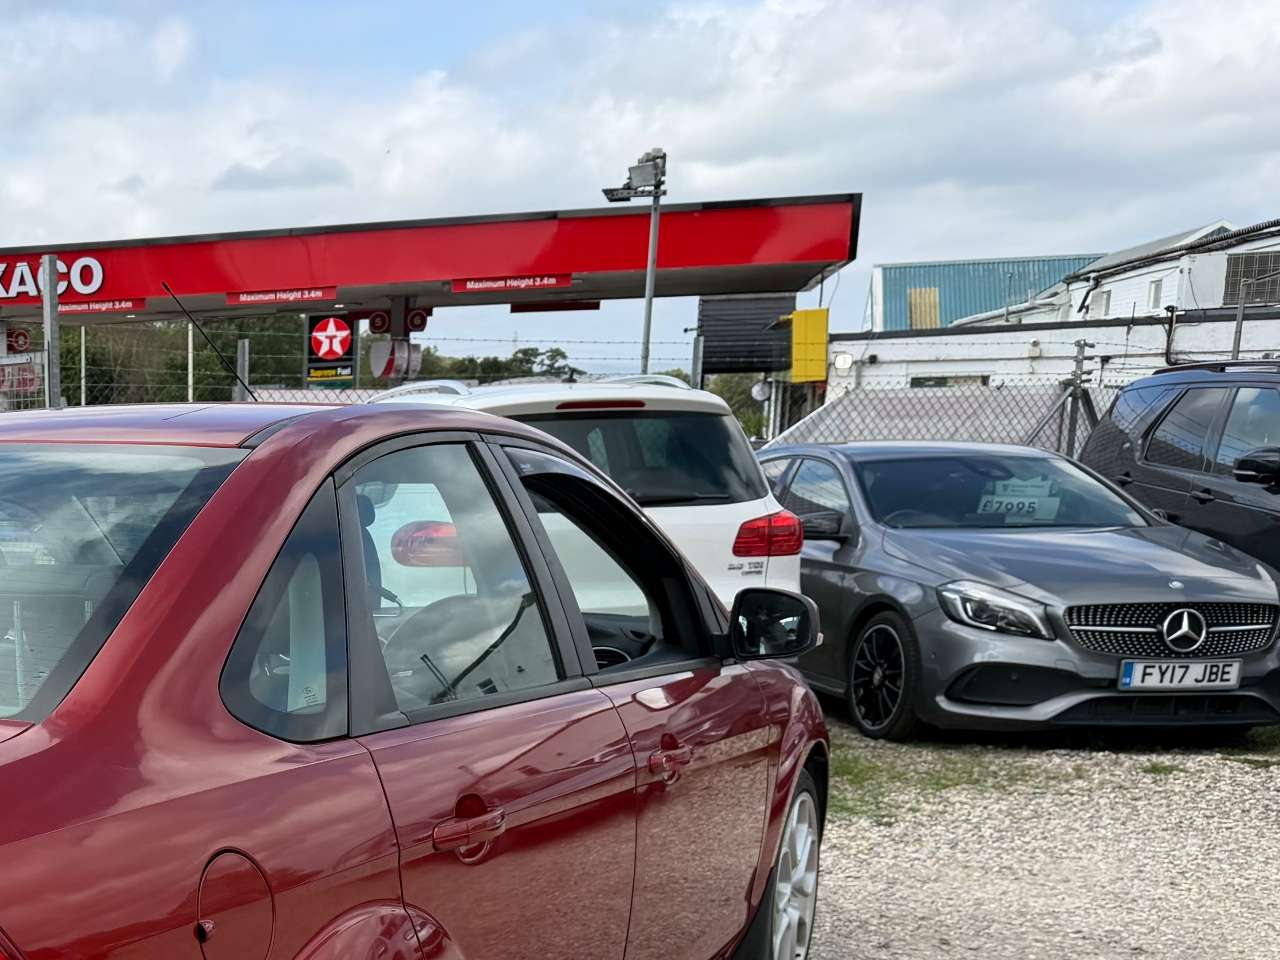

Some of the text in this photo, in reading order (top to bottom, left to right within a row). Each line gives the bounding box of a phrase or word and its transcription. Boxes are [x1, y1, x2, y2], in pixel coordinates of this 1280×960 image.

[465, 277, 557, 289] Maximum Height 3.4m
[239, 289, 323, 302] Maximum Height 3.4m
[982, 500, 1037, 514] £7995
[1140, 663, 1234, 684] FY17 JBE
